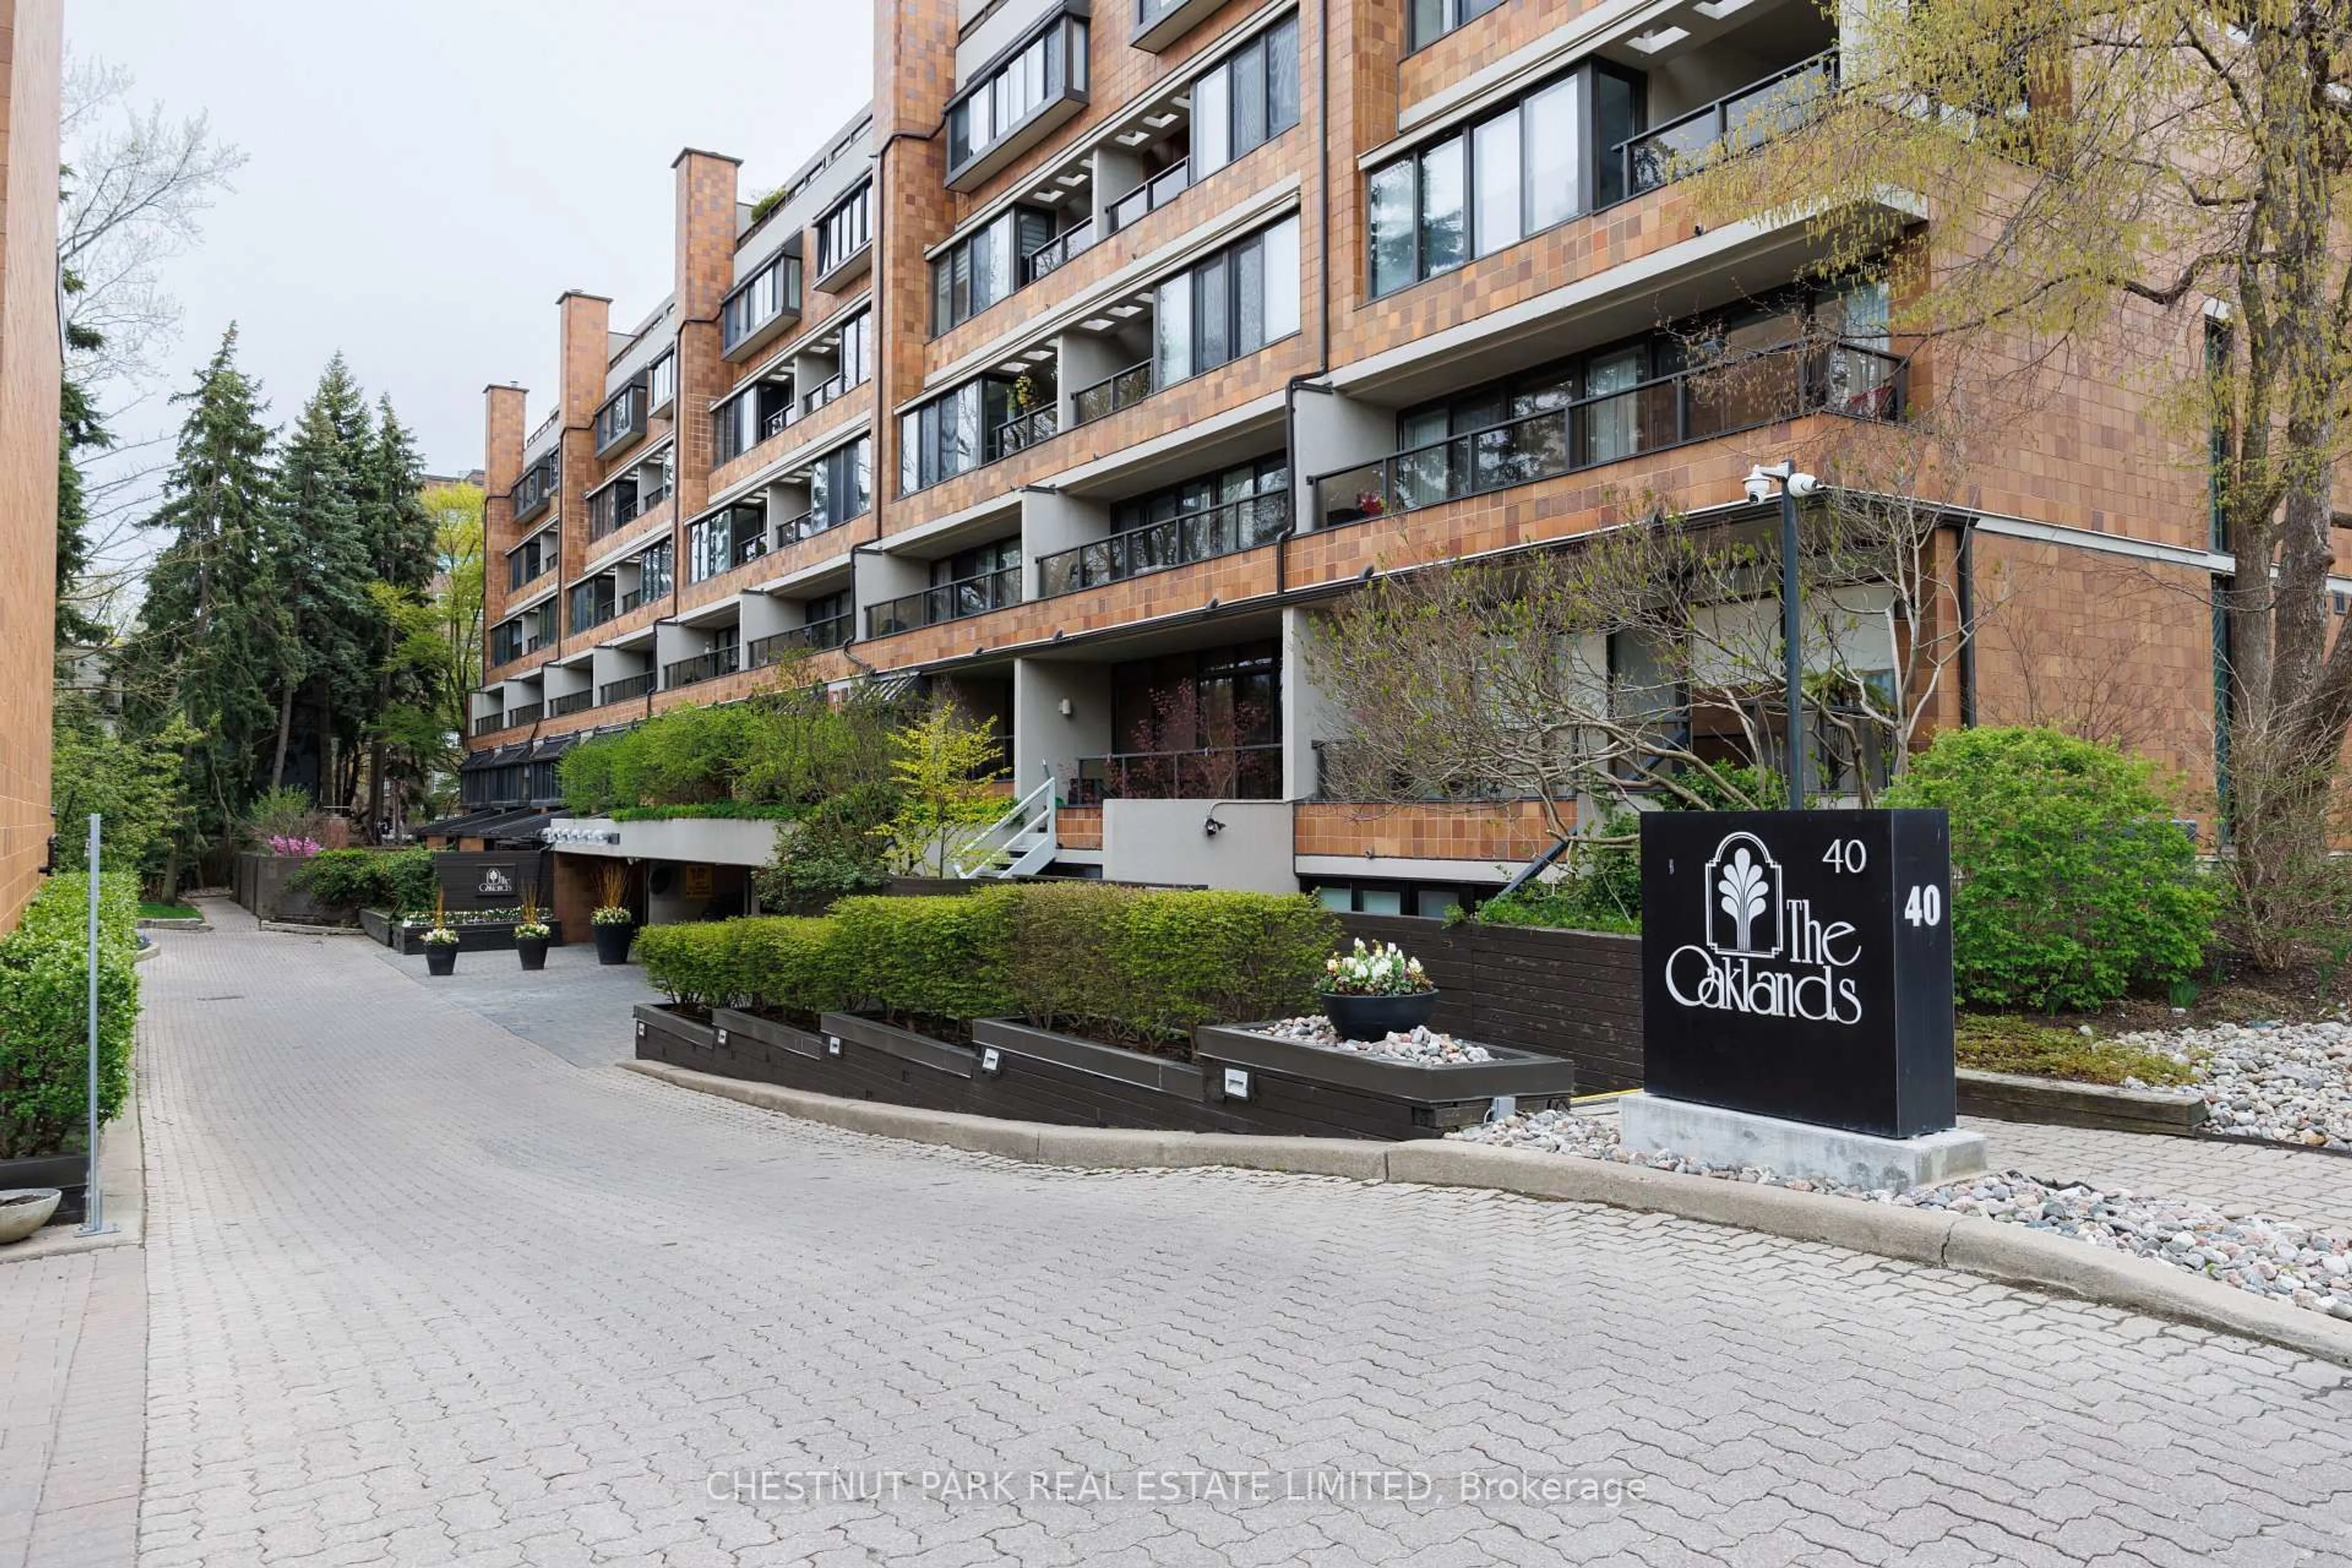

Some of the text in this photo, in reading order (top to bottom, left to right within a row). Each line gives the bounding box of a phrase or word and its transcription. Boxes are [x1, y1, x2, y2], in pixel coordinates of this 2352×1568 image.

[1822, 839, 1867, 873] 40
[1787, 899, 1862, 967] The
[1904, 884, 1941, 927] 40
[1665, 944, 1863, 1025] Oaklands
